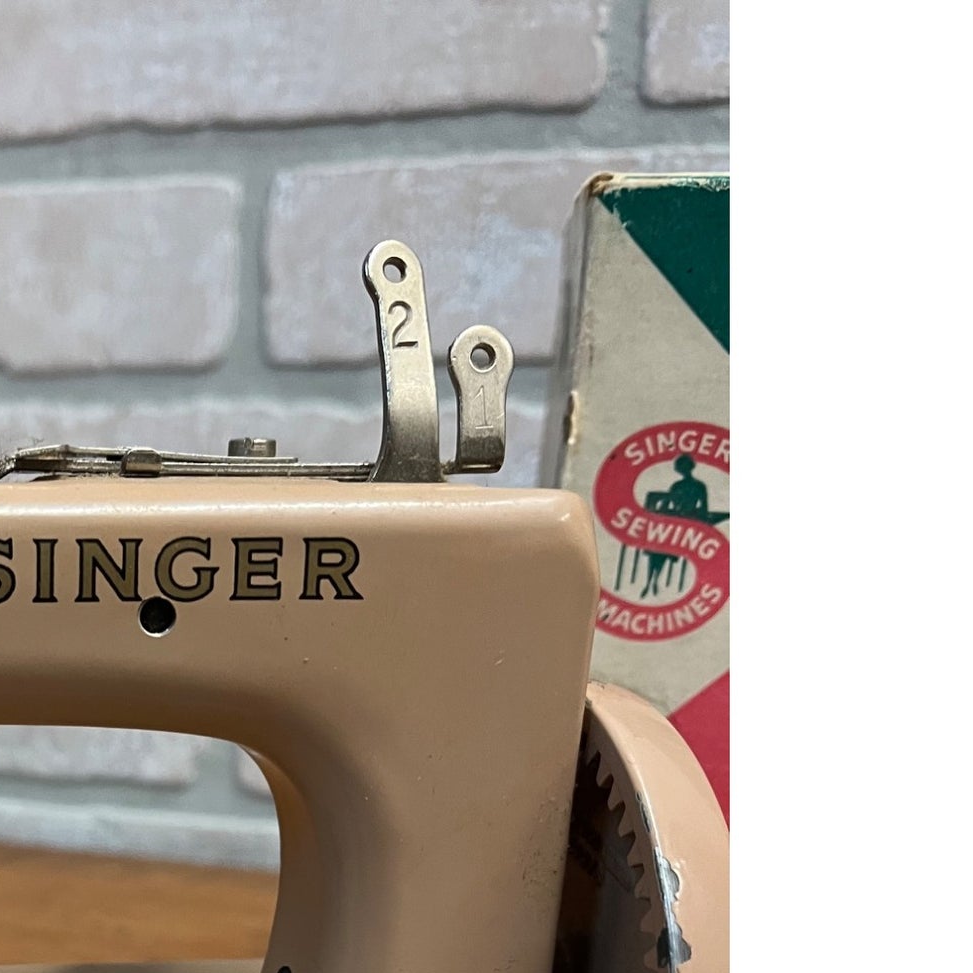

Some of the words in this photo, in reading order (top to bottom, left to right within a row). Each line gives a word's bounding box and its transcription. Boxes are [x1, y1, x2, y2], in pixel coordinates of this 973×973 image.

[387, 299, 419, 349] 2
[474, 384, 495, 430] 1
[624, 429, 729, 466] SINGER
[610, 507, 721, 560] SEWING
[596, 583, 722, 635] MACHINES
